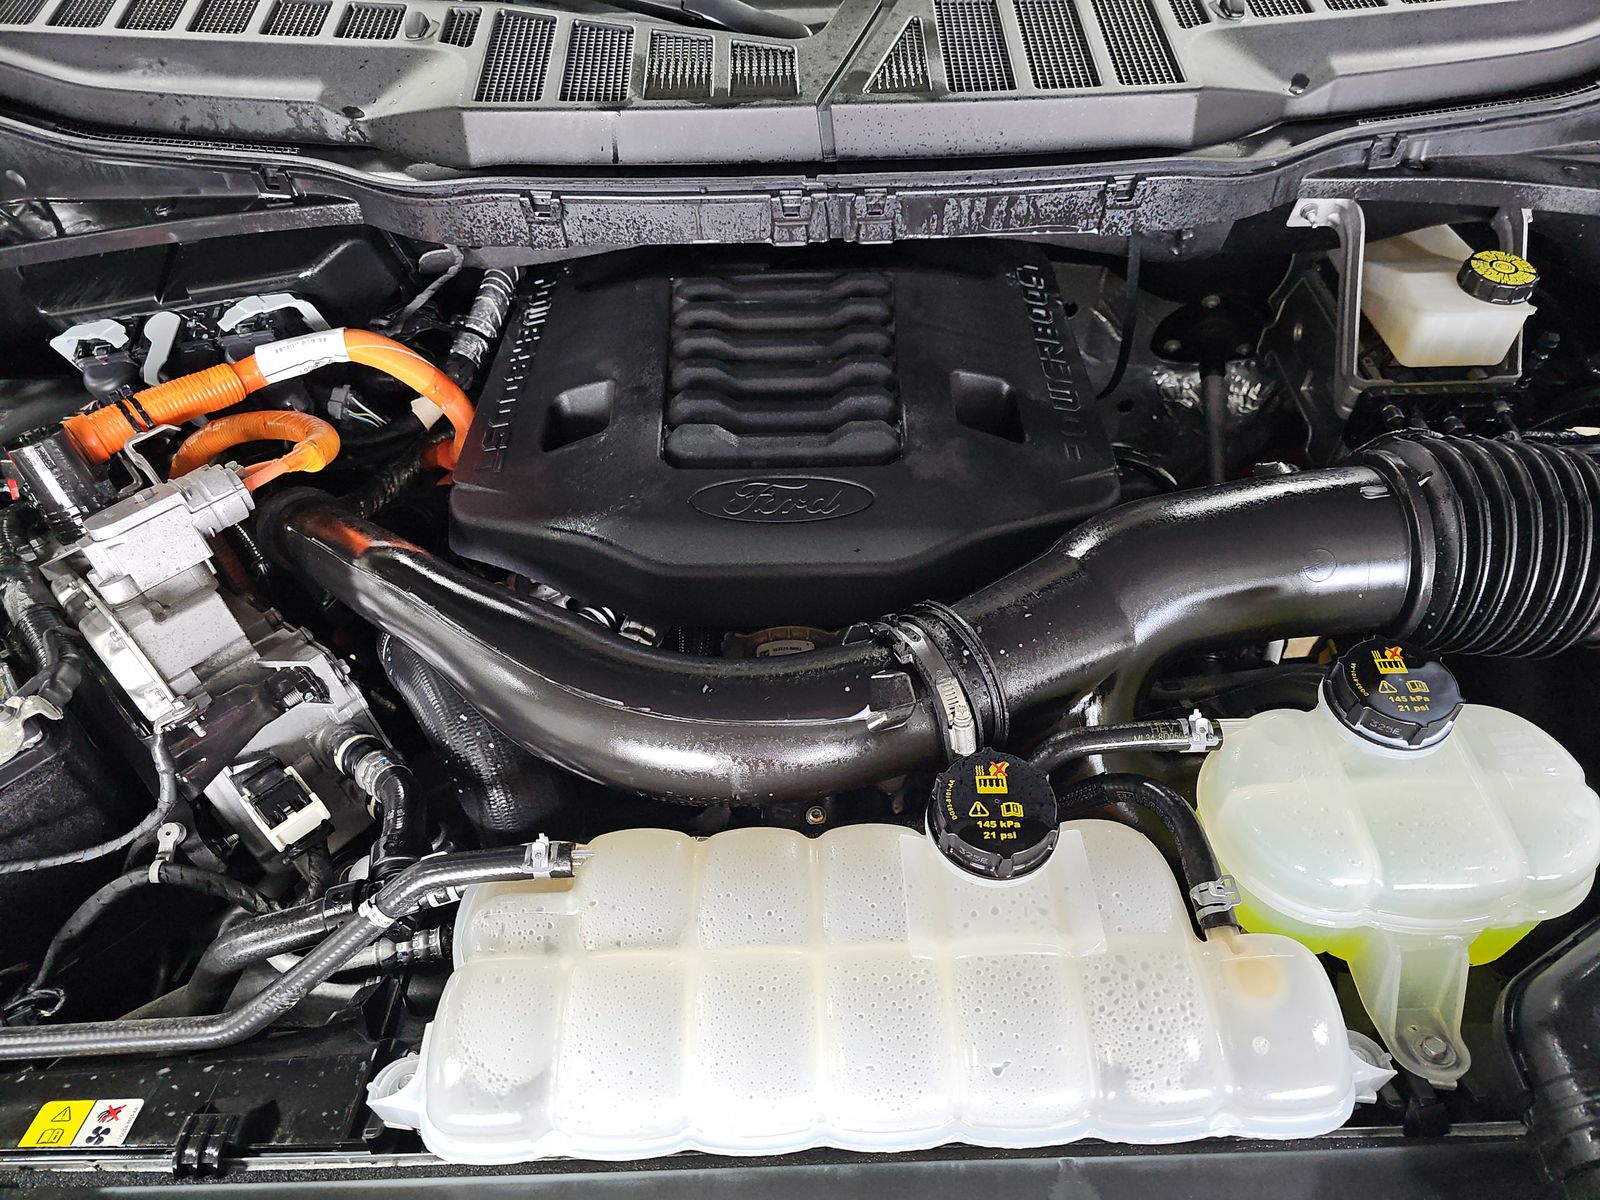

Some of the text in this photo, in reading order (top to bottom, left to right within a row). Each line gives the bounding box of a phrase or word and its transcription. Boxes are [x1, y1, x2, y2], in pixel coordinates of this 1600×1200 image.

[722, 482, 843, 515] Ford
[1388, 695, 1408, 703] 145
[1397, 704, 1430, 713] 21 psi
[1150, 724, 1175, 734] HEV
[976, 820, 1021, 829] 145 kPa
[983, 831, 1017, 841] 21 psi
